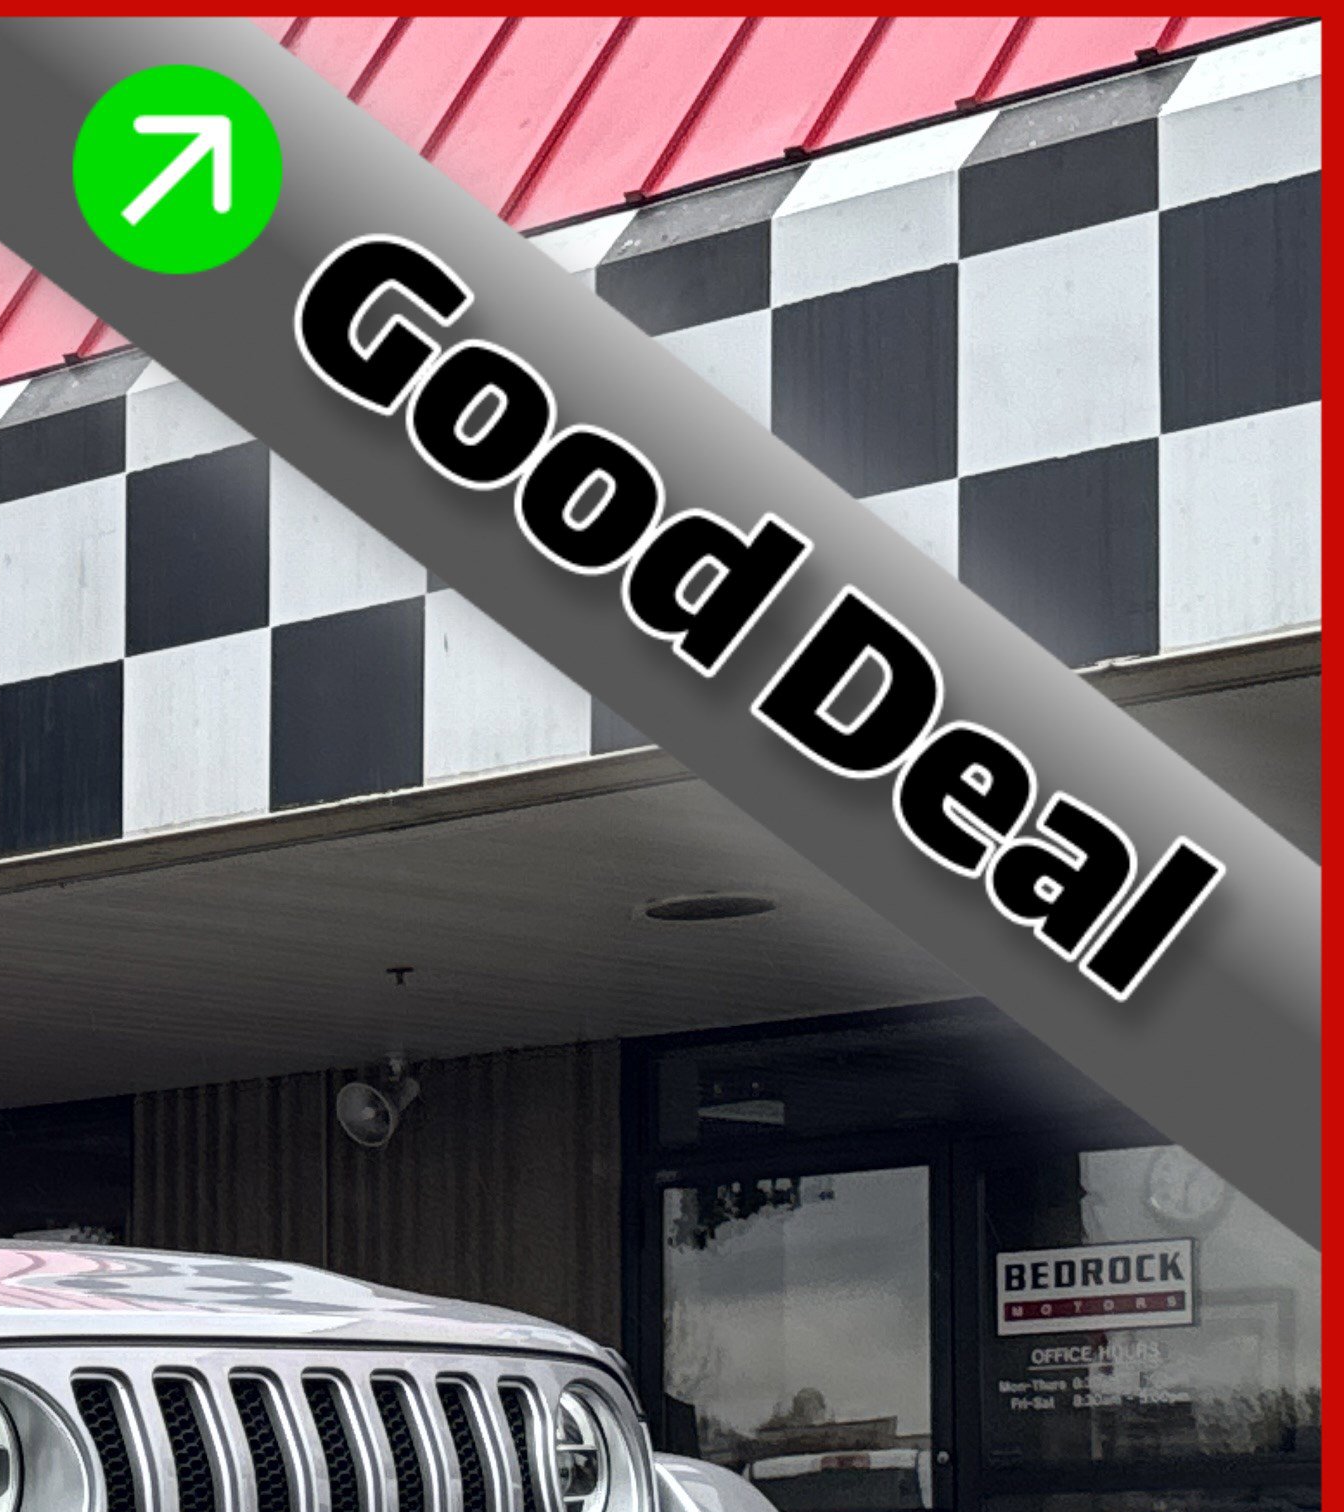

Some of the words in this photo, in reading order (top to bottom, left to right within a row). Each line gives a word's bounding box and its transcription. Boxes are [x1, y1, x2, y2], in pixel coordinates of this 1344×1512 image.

[1004, 1251, 1185, 1292] BEDROCK
[1012, 1297, 1178, 1317] MOTORS
[1031, 1345, 1092, 1365] OFFICE
[1098, 1342, 1161, 1362] HOURS
